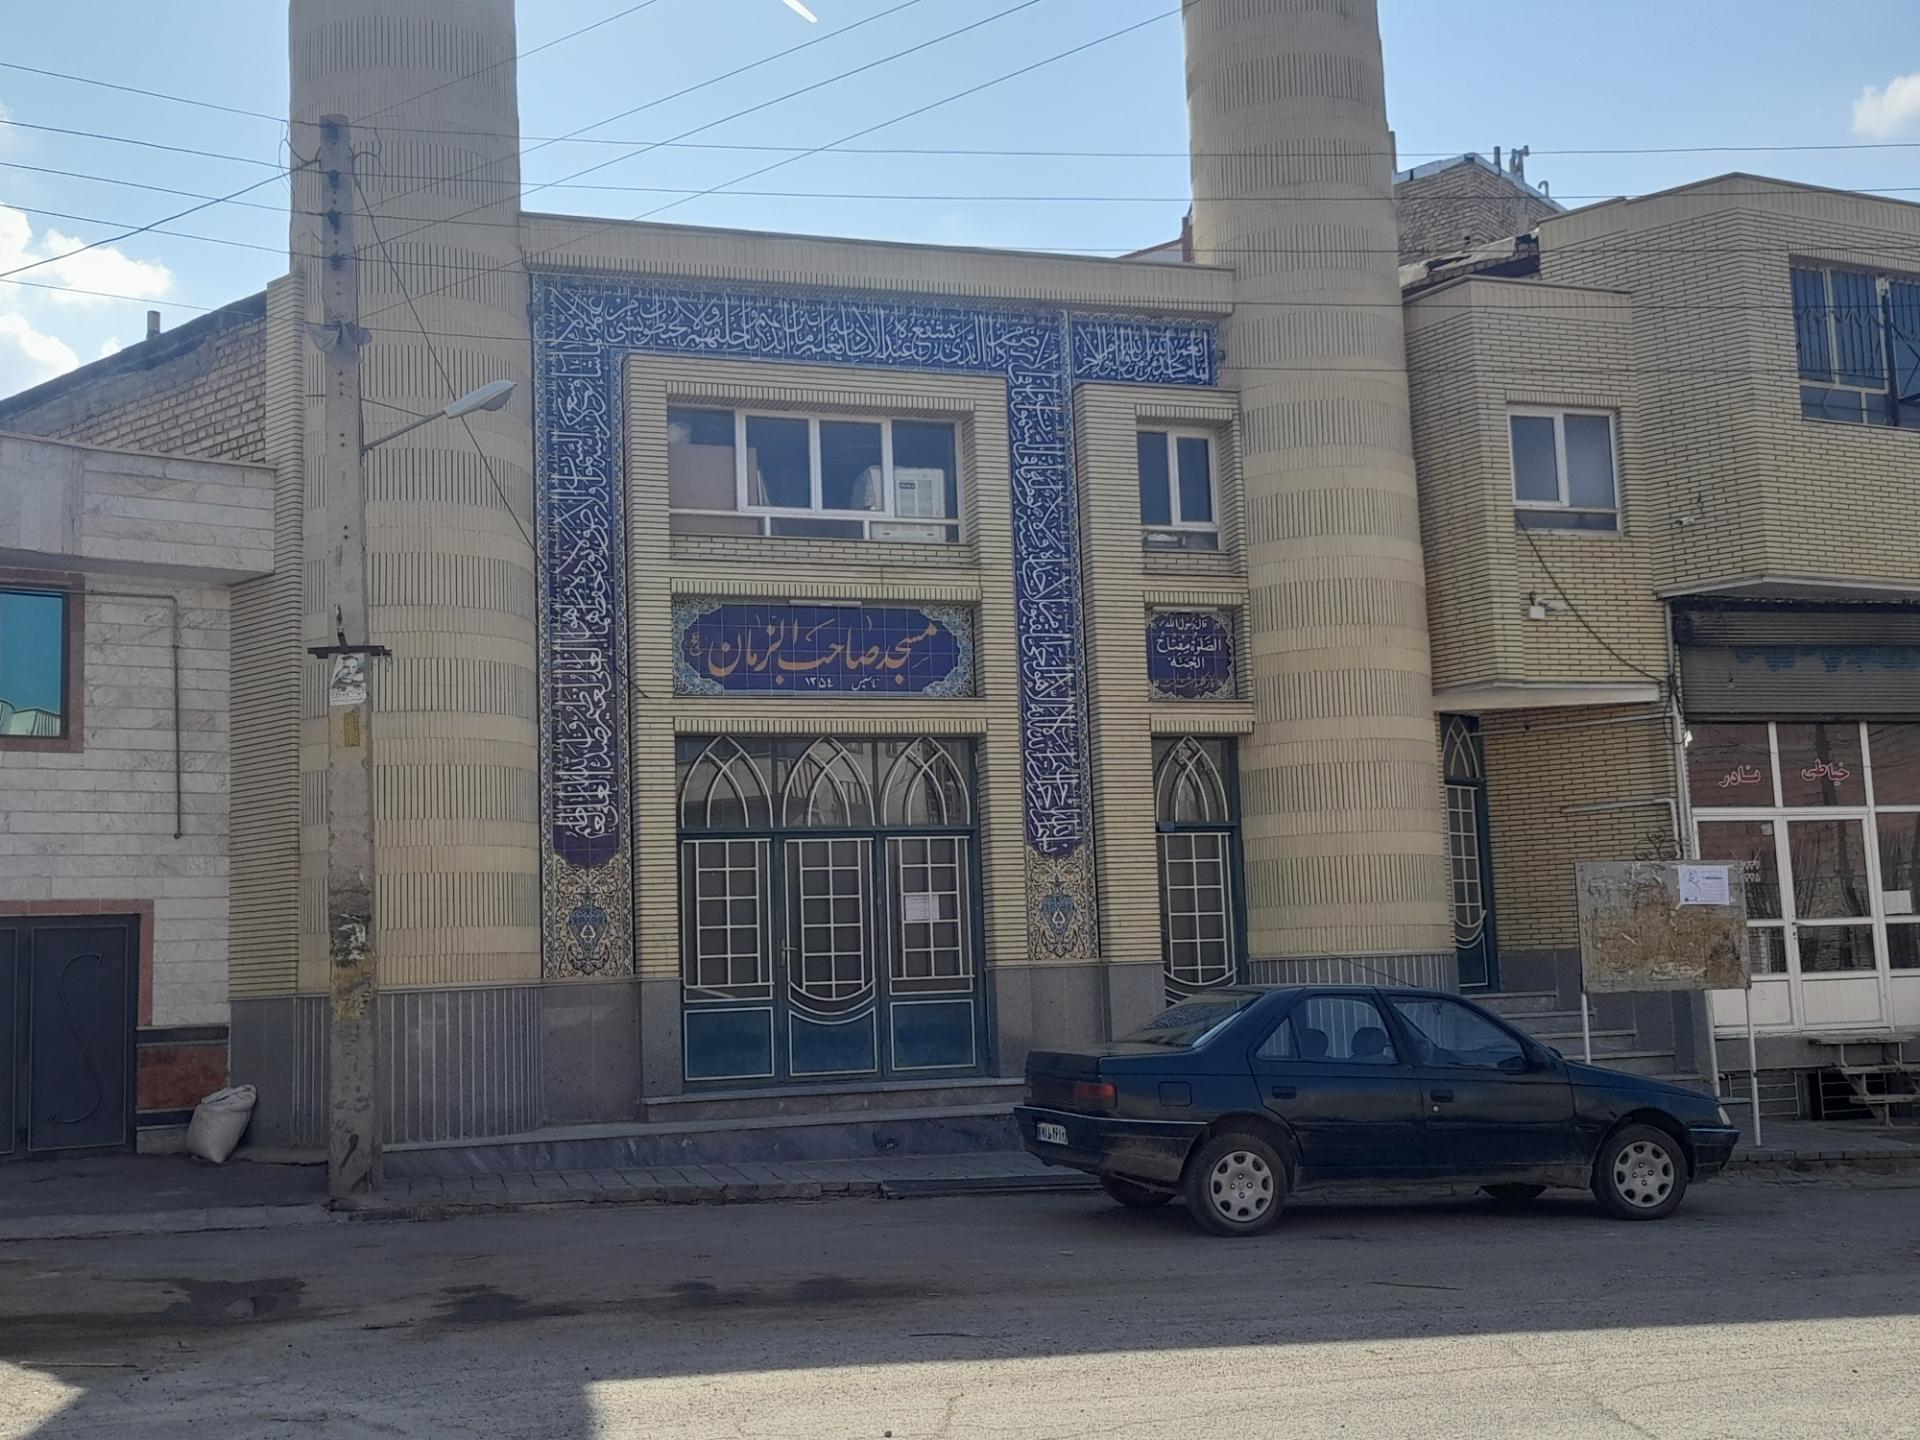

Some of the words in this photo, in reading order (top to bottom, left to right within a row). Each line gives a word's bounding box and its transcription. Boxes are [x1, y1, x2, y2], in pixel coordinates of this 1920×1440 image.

[707, 616, 798, 678] الزمان
[776, 626, 879, 686] صاحب
[876, 620, 938, 685] مسجد
[1718, 764, 1761, 788] نادر
